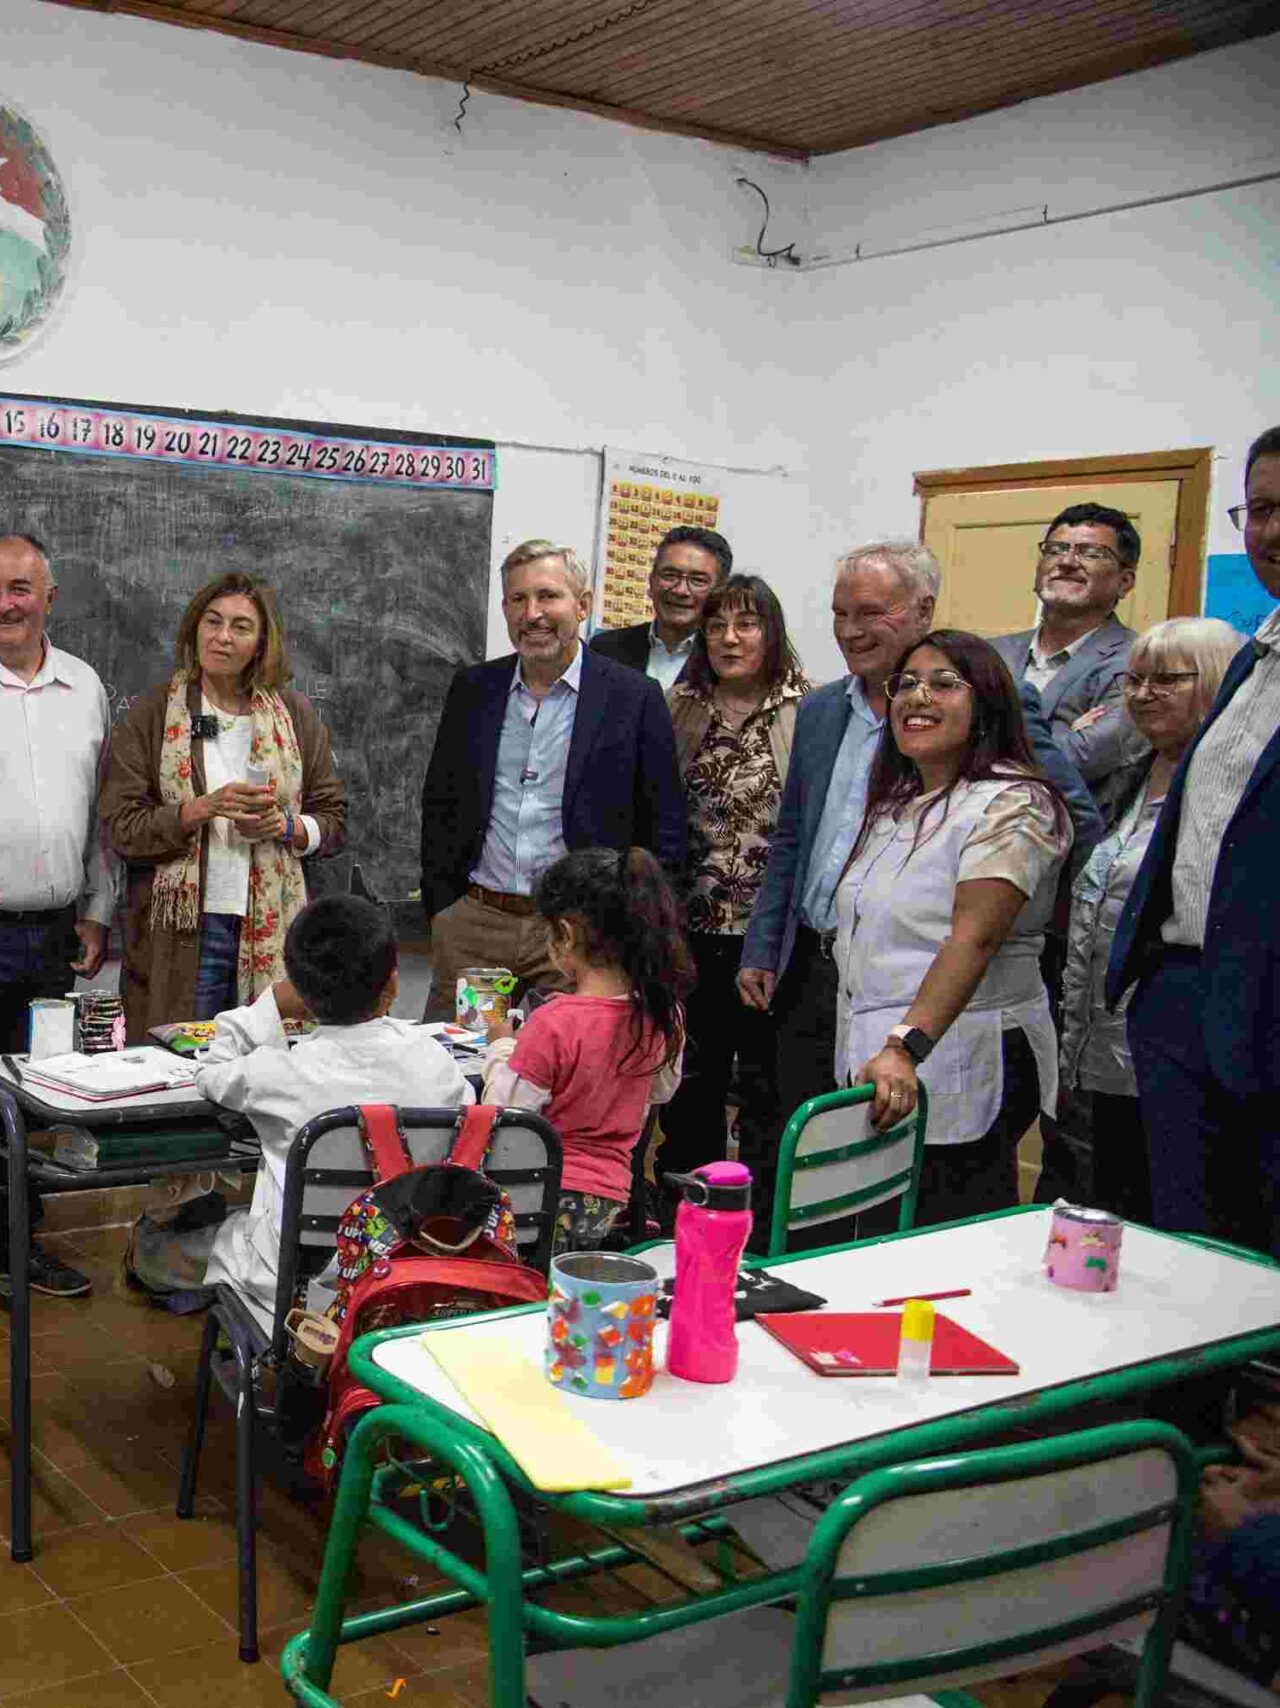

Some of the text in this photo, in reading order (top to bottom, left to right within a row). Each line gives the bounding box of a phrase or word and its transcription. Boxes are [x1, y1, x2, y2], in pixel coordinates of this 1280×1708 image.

[5, 409, 25, 434] 15
[40, 412, 60, 439] 16
[72, 418, 92, 443] 17
[104, 422, 124, 447] 18
[136, 425, 156, 450] 19
[164, 430, 191, 454] 20
[198, 432, 217, 457] 21
[226, 435, 251, 461] 22
[257, 440, 282, 465] 23
[285, 443, 311, 469] 24
[315, 446, 340, 471] 25
[342, 447, 366, 473] 26
[369, 451, 390, 474] 27
[395, 453, 416, 476] 28
[420, 454, 441, 479] 29
[445, 456, 465, 479] 30
[472, 457, 486, 480] 31
